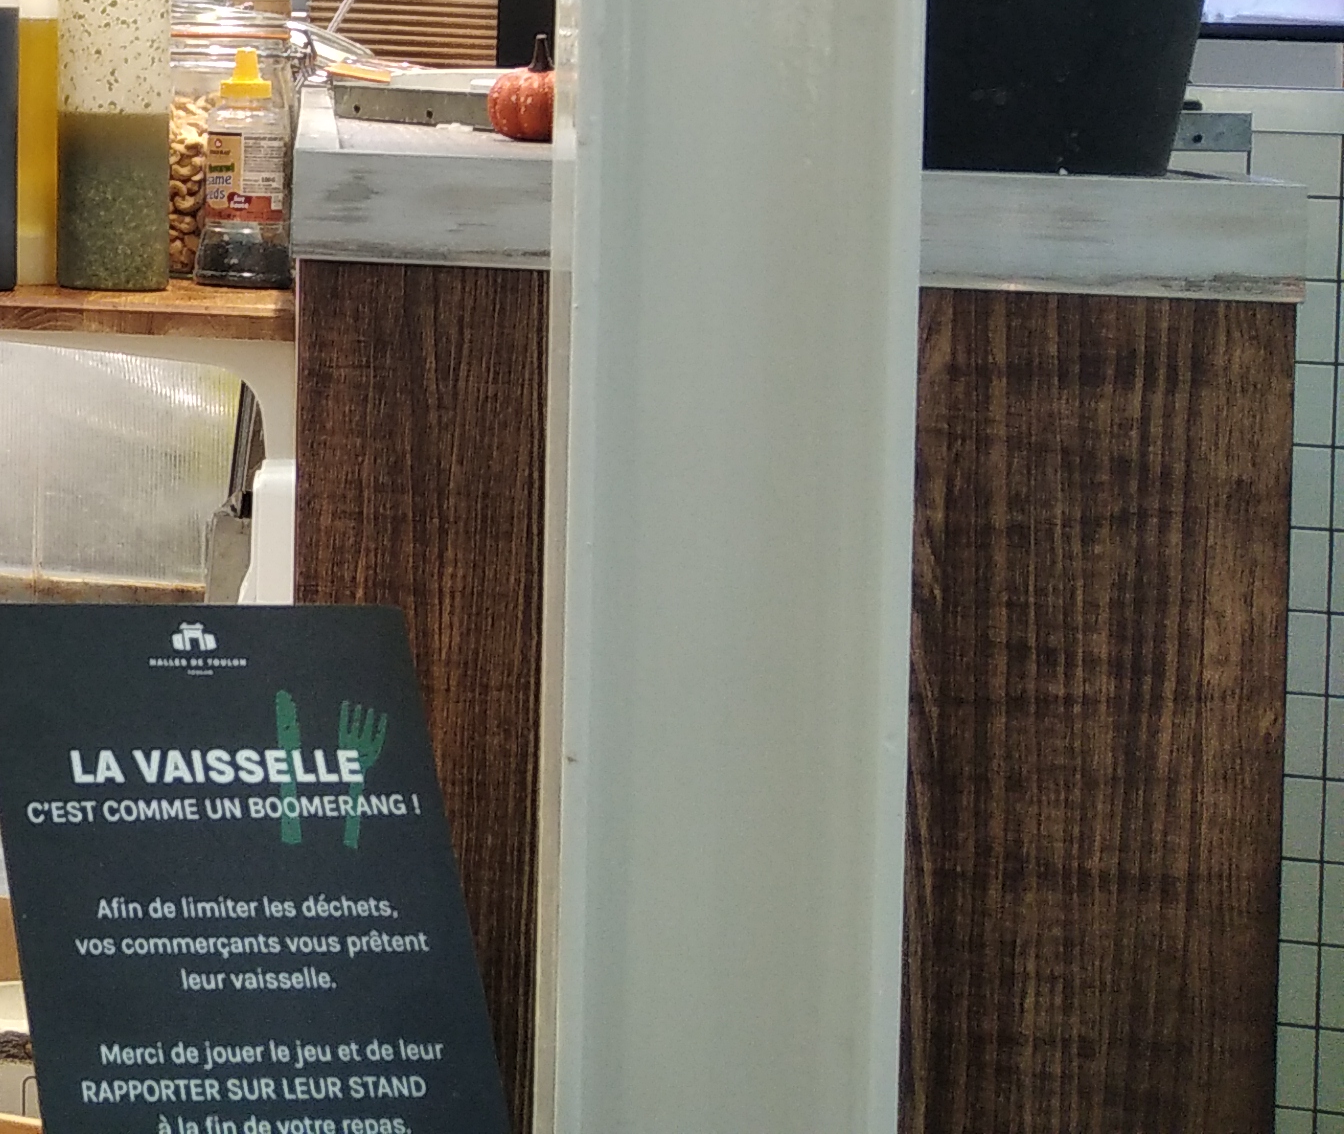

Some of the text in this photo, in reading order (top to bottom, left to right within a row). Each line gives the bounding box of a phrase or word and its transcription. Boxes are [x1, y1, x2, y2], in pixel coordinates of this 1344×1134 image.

[207, 657, 248, 667] TOULON
[69, 748, 365, 784] LA VAISSELLE
[27, 800, 96, 824] C'EST
[102, 799, 198, 823] COMME
[205, 798, 243, 820] UN
[248, 795, 406, 821] BOOMERANG
[96, 893, 400, 920] Afin de limiter les déchets,
[74, 931, 430, 959] vos commerçants vous prêtent
[180, 968, 338, 991] leur vaisselle.
[100, 1039, 444, 1070] Merci de jouer le jeu et de leur
[81, 1076, 427, 1103] RAPPORTER SUR LEUR STAND
[158, 1114, 171, 1134] à
[177, 1116, 199, 1134] la
[205, 1115, 238, 1134] fin
[243, 1115, 273, 1134] de
[275, 1116, 336, 1134] votre
